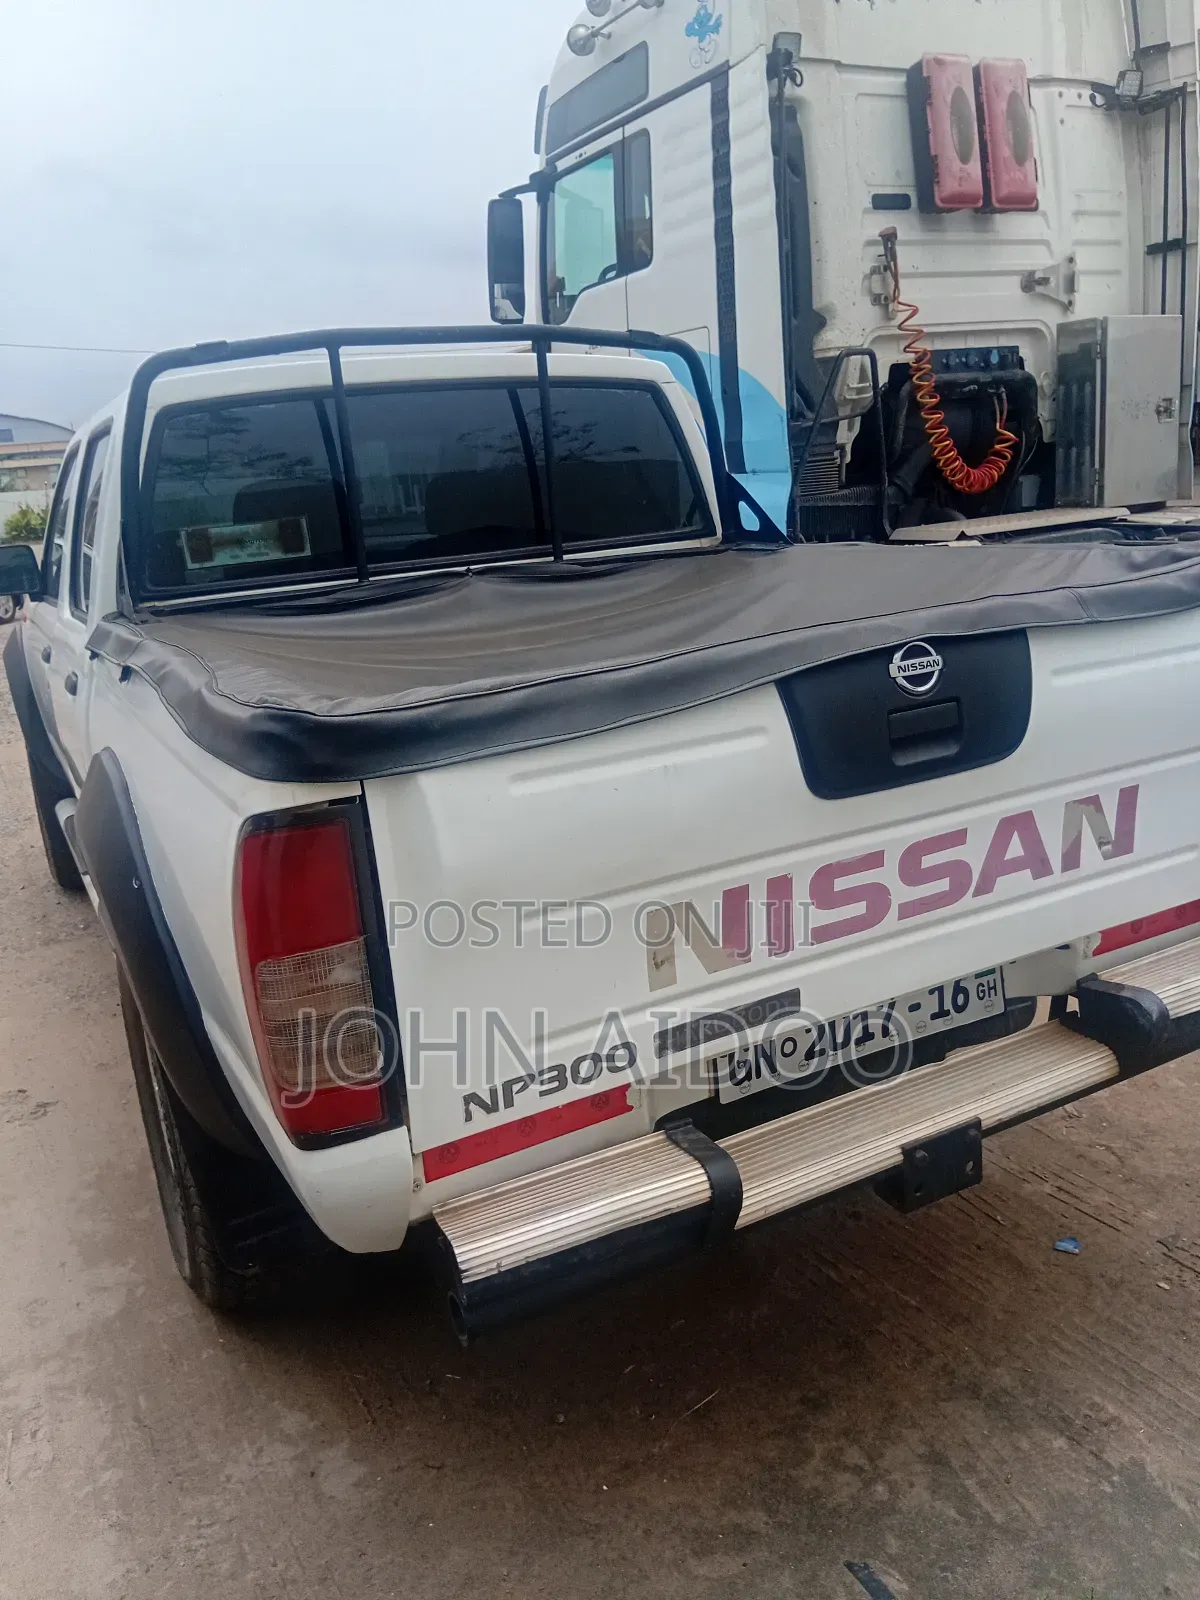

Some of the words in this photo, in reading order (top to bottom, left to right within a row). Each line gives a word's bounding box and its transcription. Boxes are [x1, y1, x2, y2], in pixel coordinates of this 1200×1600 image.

[897, 659, 940, 674] NISSAN
[647, 784, 1140, 993] NISSAN
[976, 978, 998, 1001] GH
[462, 1041, 637, 1123] NP300
